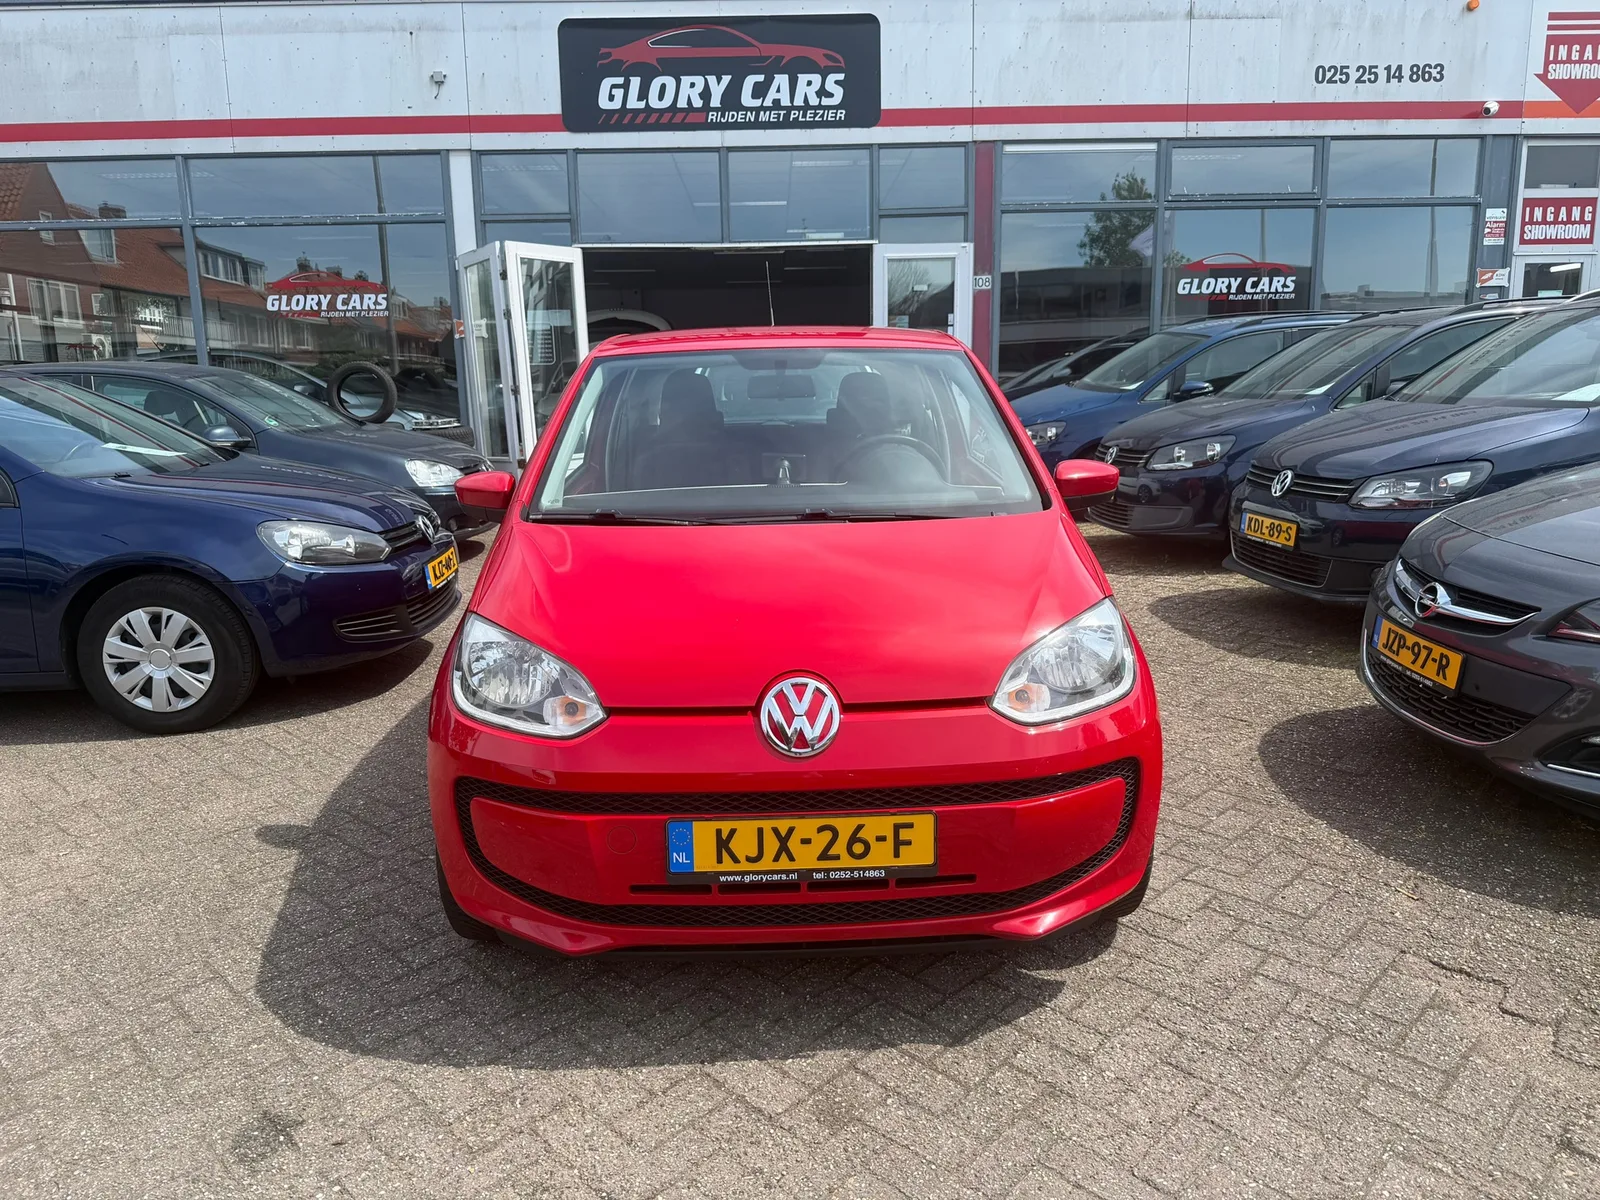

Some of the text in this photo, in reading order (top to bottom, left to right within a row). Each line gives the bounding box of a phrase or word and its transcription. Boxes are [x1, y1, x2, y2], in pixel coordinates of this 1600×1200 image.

[1549, 44, 1600, 61] INGA
[1314, 63, 1445, 84] 025 25 14 863
[1547, 63, 1600, 80] SHOWRO
[597, 73, 846, 110] GLORY CARS
[707, 109, 846, 123] RIJDEN MET PLEZIER
[1525, 205, 1593, 222] INGANG
[1523, 224, 1591, 240] SHOWROOM
[974, 277, 991, 288] 108
[1177, 276, 1296, 295] GLORY CARS
[266, 293, 388, 311] GLORY CARS
[1246, 515, 1293, 543] KDL-89-S
[1381, 627, 1451, 681] JZP-97-R
[715, 821, 915, 864] KJX-26-F
[673, 852, 691, 864] NL
[719, 869, 885, 884] www.glorycars.nl tel: 0252-514863
